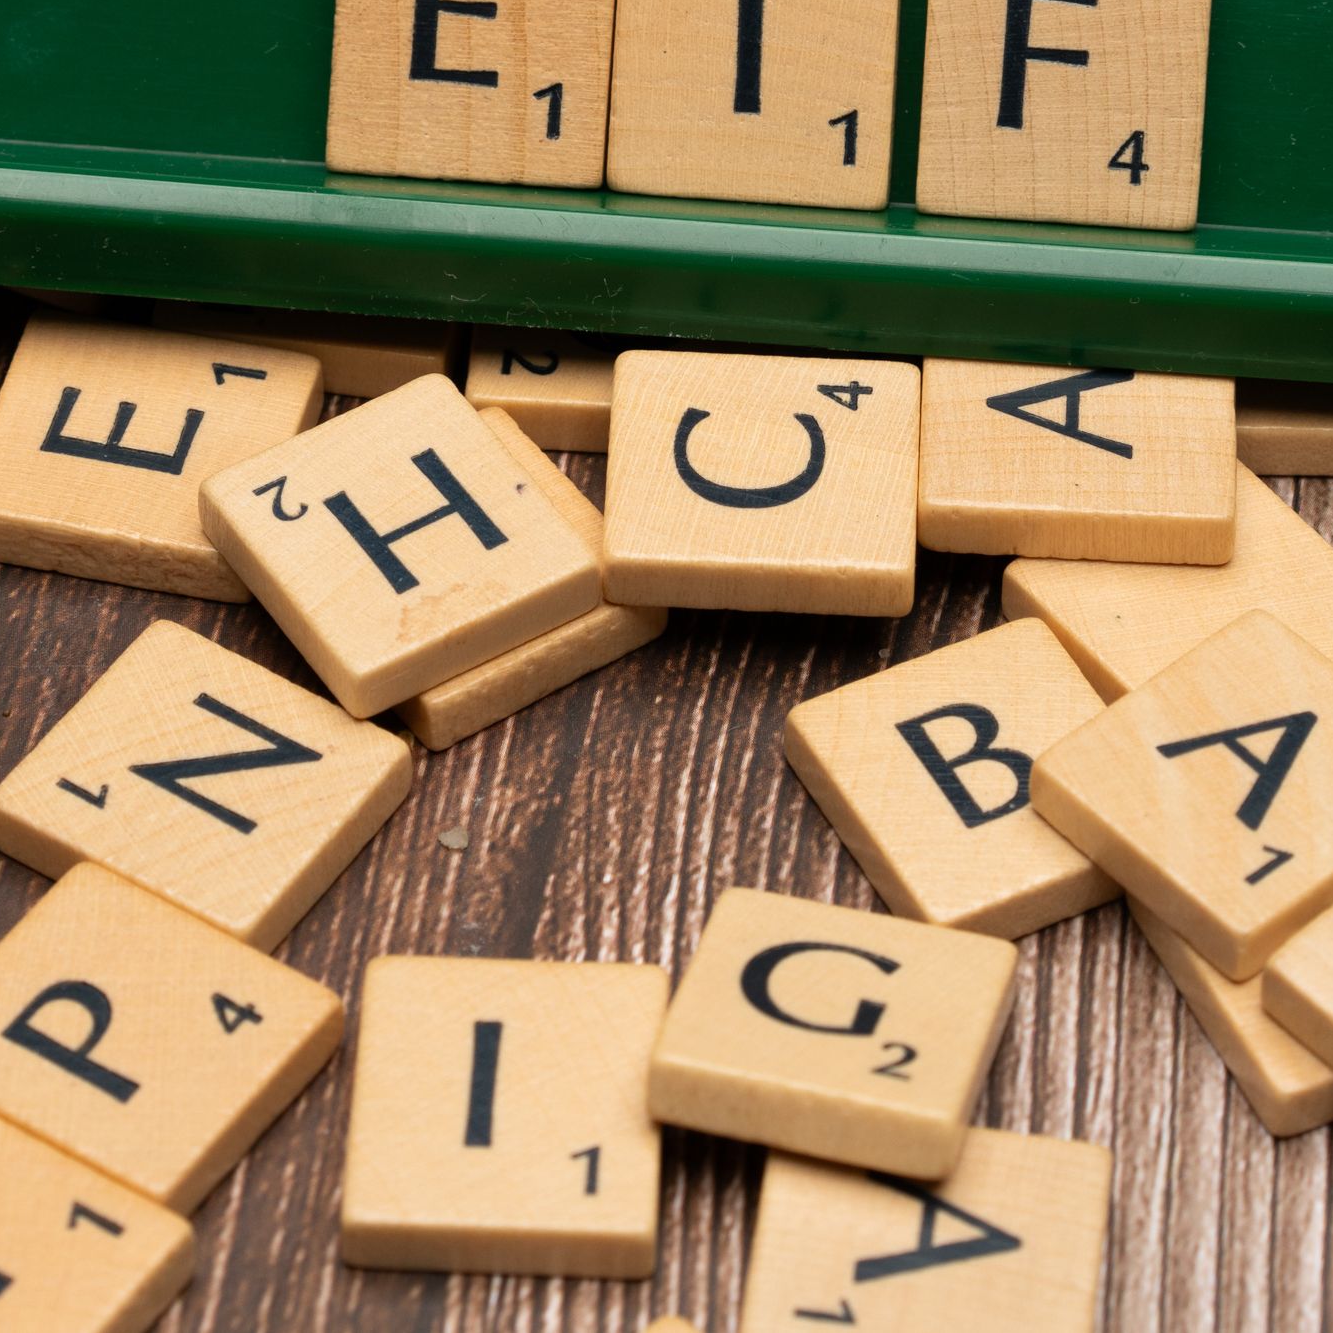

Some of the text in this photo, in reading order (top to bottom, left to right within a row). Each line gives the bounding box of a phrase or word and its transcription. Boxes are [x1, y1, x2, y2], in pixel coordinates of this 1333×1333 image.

[533, 83, 563, 140] 1
[829, 110, 858, 165] 1
[1108, 131, 1149, 186] 4
[40, 387, 204, 475] E
[674, 381, 873, 508] C 4
[985, 367, 1136, 460] A
[253, 448, 508, 594] H 2
[57, 691, 324, 836] N 1
[895, 704, 1033, 828] B
[1157, 712, 1317, 885] A 1
[2, 981, 262, 1102] P 4
[741, 942, 916, 1077] G 2
[70, 1203, 123, 1236] 1
[573, 1147, 599, 1194] 1
[855, 1180, 1020, 1281] A
